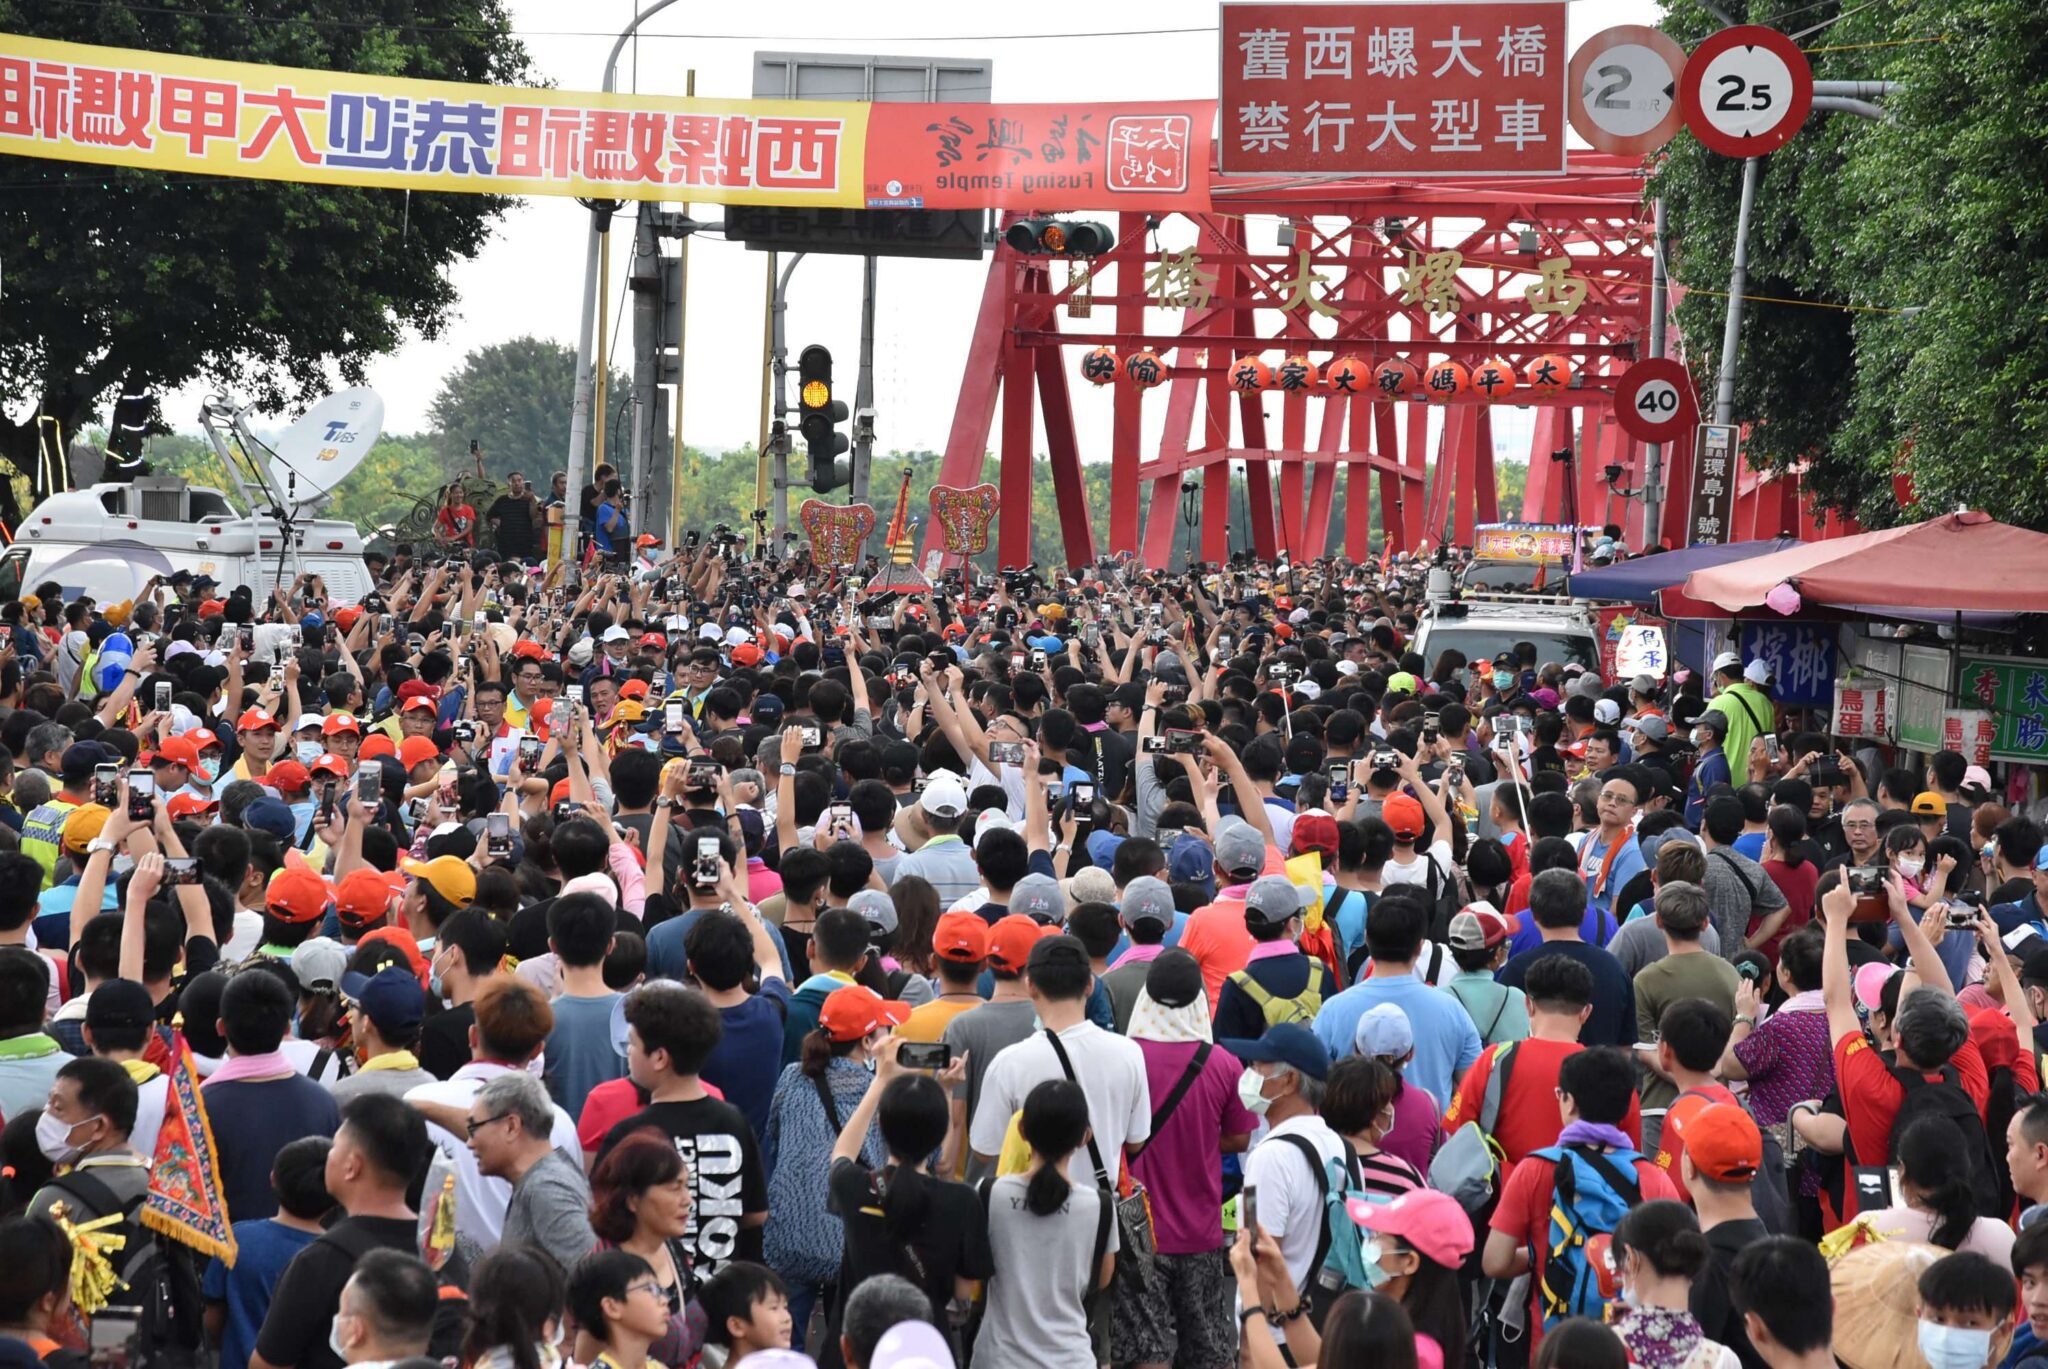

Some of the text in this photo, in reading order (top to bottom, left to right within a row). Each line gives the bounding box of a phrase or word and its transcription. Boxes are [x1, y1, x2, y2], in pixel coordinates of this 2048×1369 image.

[1238, 25, 1548, 80] 舊西螺大橋
[1239, 99, 1548, 153] 禁行大型車
[1637, 389, 1676, 413] 40
[324, 420, 359, 443] TVBS
